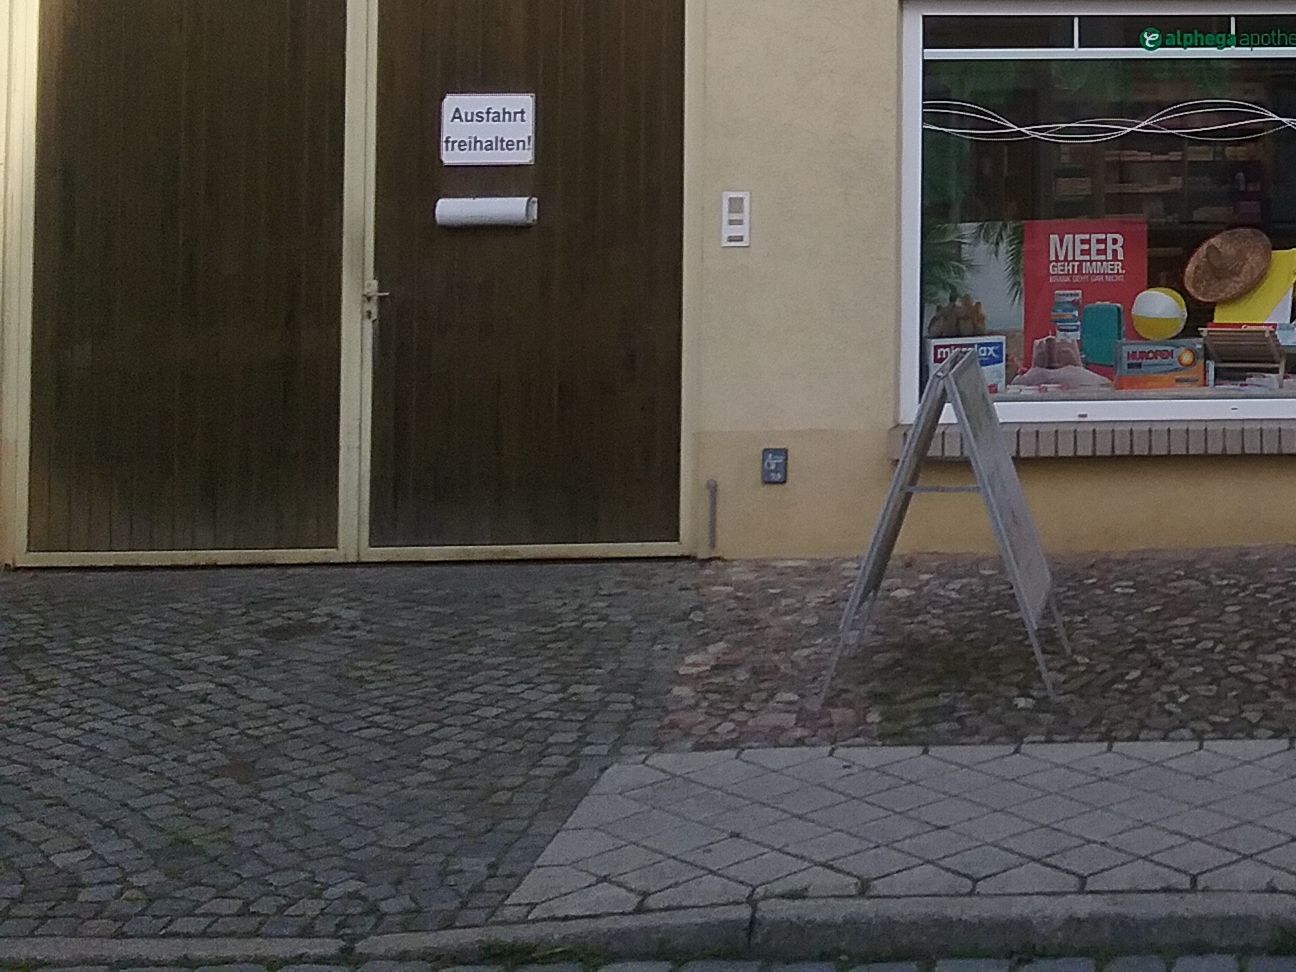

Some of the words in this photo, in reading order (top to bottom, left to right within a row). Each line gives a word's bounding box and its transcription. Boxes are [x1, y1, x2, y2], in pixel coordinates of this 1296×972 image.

[1165, 30, 1236, 50] alphega
[450, 107, 526, 123] Ausfahrt
[444, 135, 532, 152] freihalten!
[1049, 234, 1124, 260] MEER
[1049, 262, 1080, 274] GEHT
[1082, 262, 1126, 274] IMMER.
